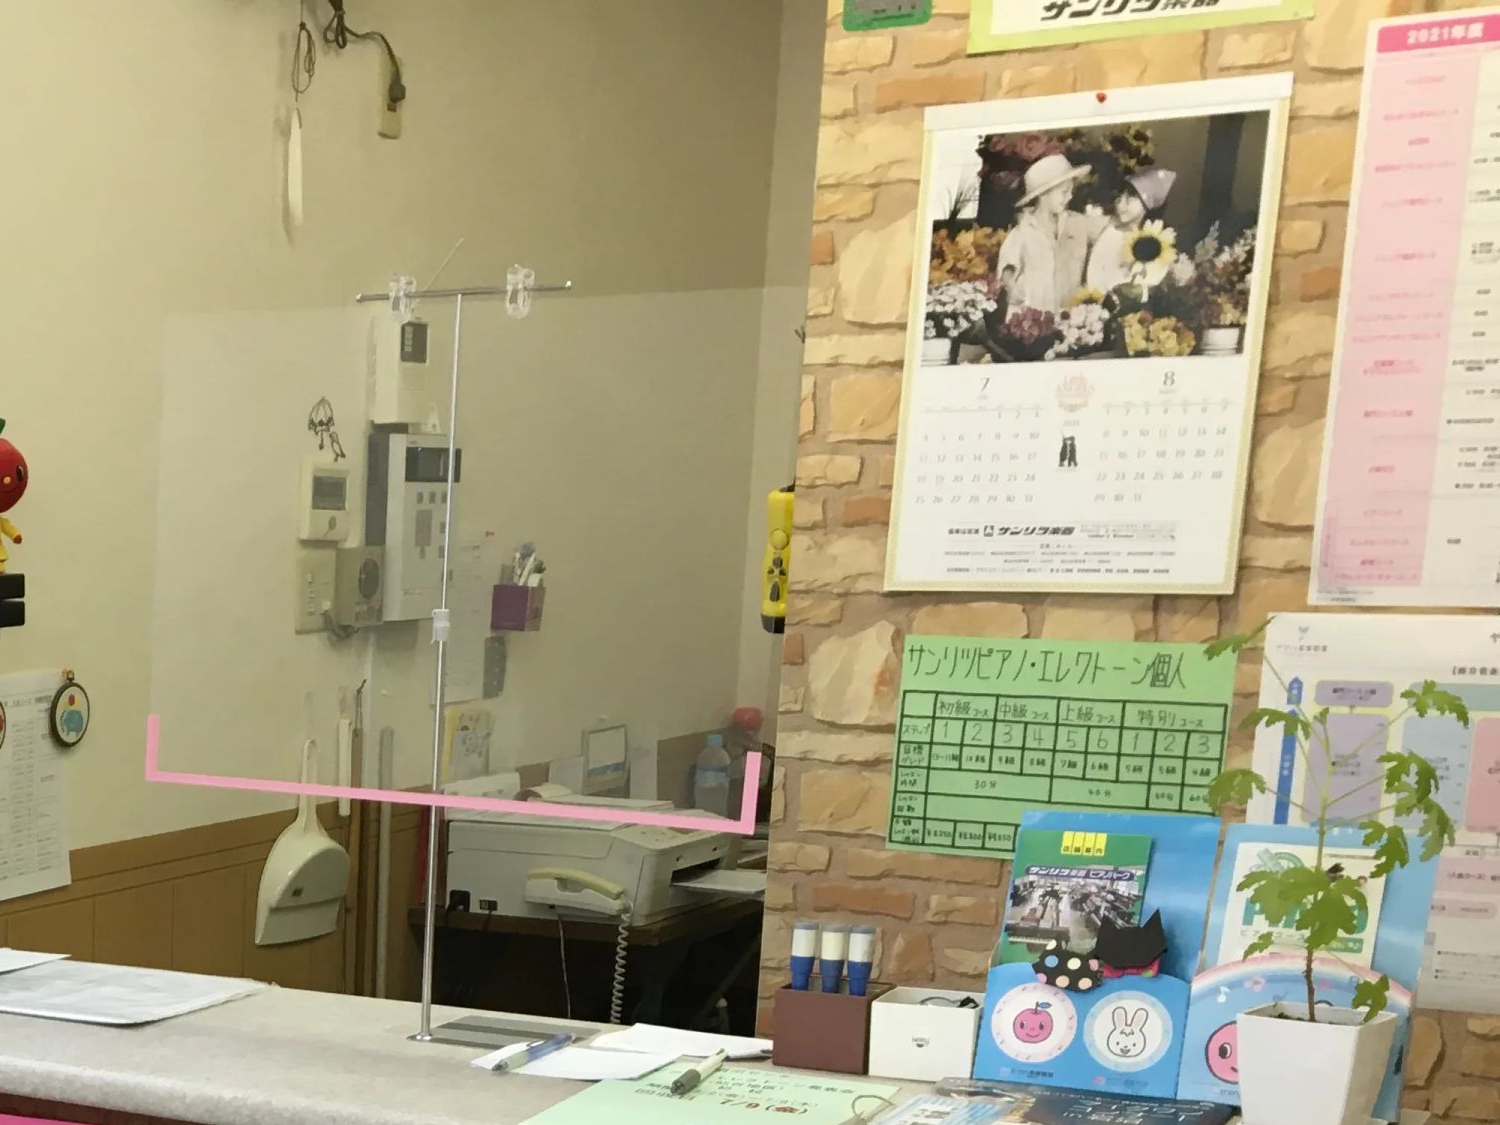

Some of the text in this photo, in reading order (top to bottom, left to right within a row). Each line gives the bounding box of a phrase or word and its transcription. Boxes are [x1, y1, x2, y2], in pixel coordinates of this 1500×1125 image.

[981, 377, 990, 391] 7
[1163, 371, 1175, 386] 8
[943, 721, 949, 738] 1
[971, 723, 983, 742] 2
[1002, 724, 1013, 743] 3
[1032, 727, 1045, 746] 4
[1066, 730, 1078, 749] 5
[1096, 730, 1109, 750] 6
[1132, 732, 1139, 751] 1
[1163, 734, 1176, 751] 2
[1198, 734, 1210, 754] 3
